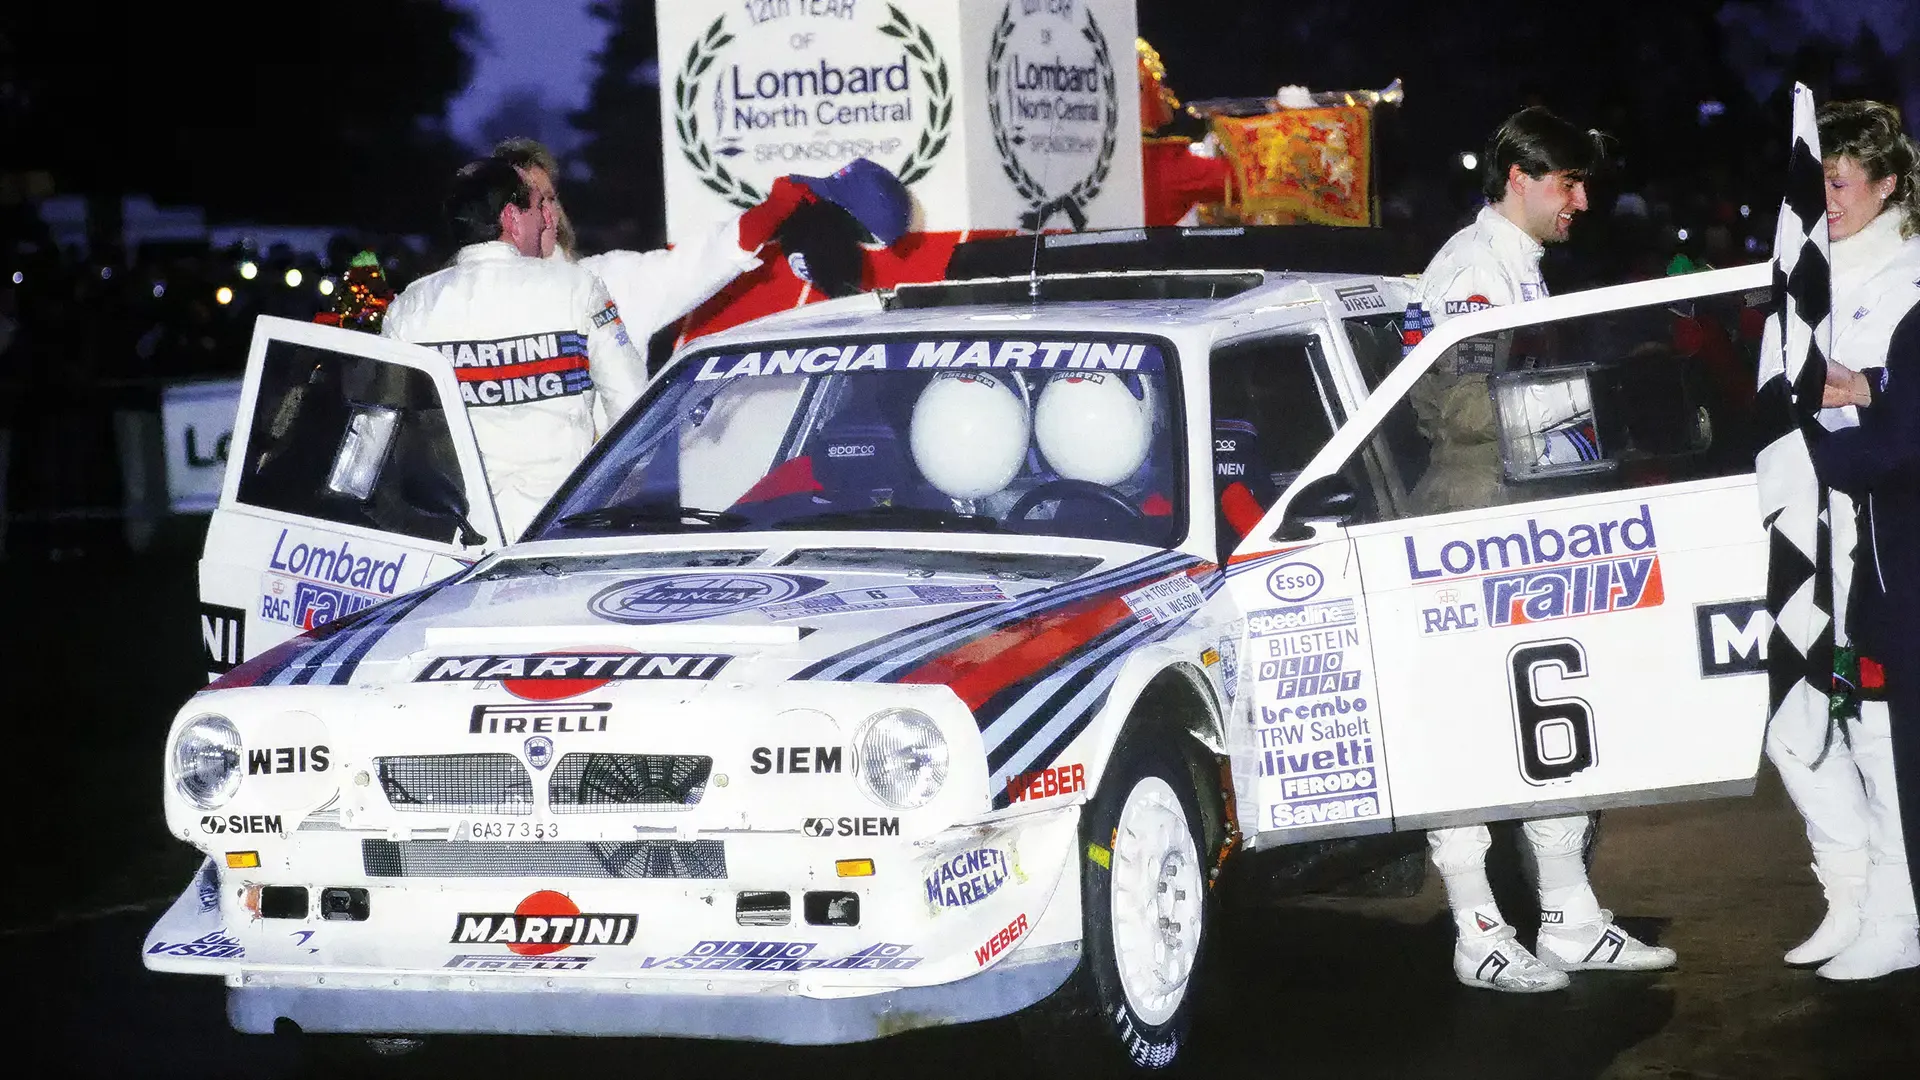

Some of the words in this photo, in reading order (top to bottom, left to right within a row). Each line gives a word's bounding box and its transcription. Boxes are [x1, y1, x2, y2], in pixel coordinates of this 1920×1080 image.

[790, 32, 815, 50] OF
[732, 54, 910, 101] Lombard
[1014, 54, 1098, 93] Lombard
[734, 103, 808, 130] North
[814, 97, 912, 126] Central
[694, 343, 888, 382] LANCIA
[907, 340, 1147, 371] MARTINI
[1404, 503, 1657, 580] Lombard
[269, 528, 407, 595] Lombard
[1492, 555, 1658, 627] rally
[261, 595, 290, 622] RAC
[1249, 605, 1344, 634] speedline
[1423, 603, 1479, 634] RAC
[1268, 627, 1359, 657] BILSTEIN
[1710, 608, 1768, 665] M
[428, 655, 720, 680] MARTINI
[1261, 653, 1342, 681] OLIO
[1279, 671, 1359, 698] FIAT
[468, 702, 613, 733] PIRELLI
[1261, 695, 1368, 725] brembo
[1506, 636, 1599, 787] 6
[1258, 724, 1304, 749] TRW
[1310, 716, 1371, 742] Sabelt
[750, 745, 842, 775] SIEM
[1005, 762, 1087, 804] WEBER
[1284, 770, 1374, 798] FERODO
[228, 814, 283, 834] SIEM
[837, 816, 900, 837] SIEM
[1273, 796, 1378, 828] Savara
[458, 917, 630, 944] MARTINI
[974, 912, 1028, 967] WEBER
[443, 954, 596, 970] PIRELLI
[690, 941, 814, 957] OLIO
